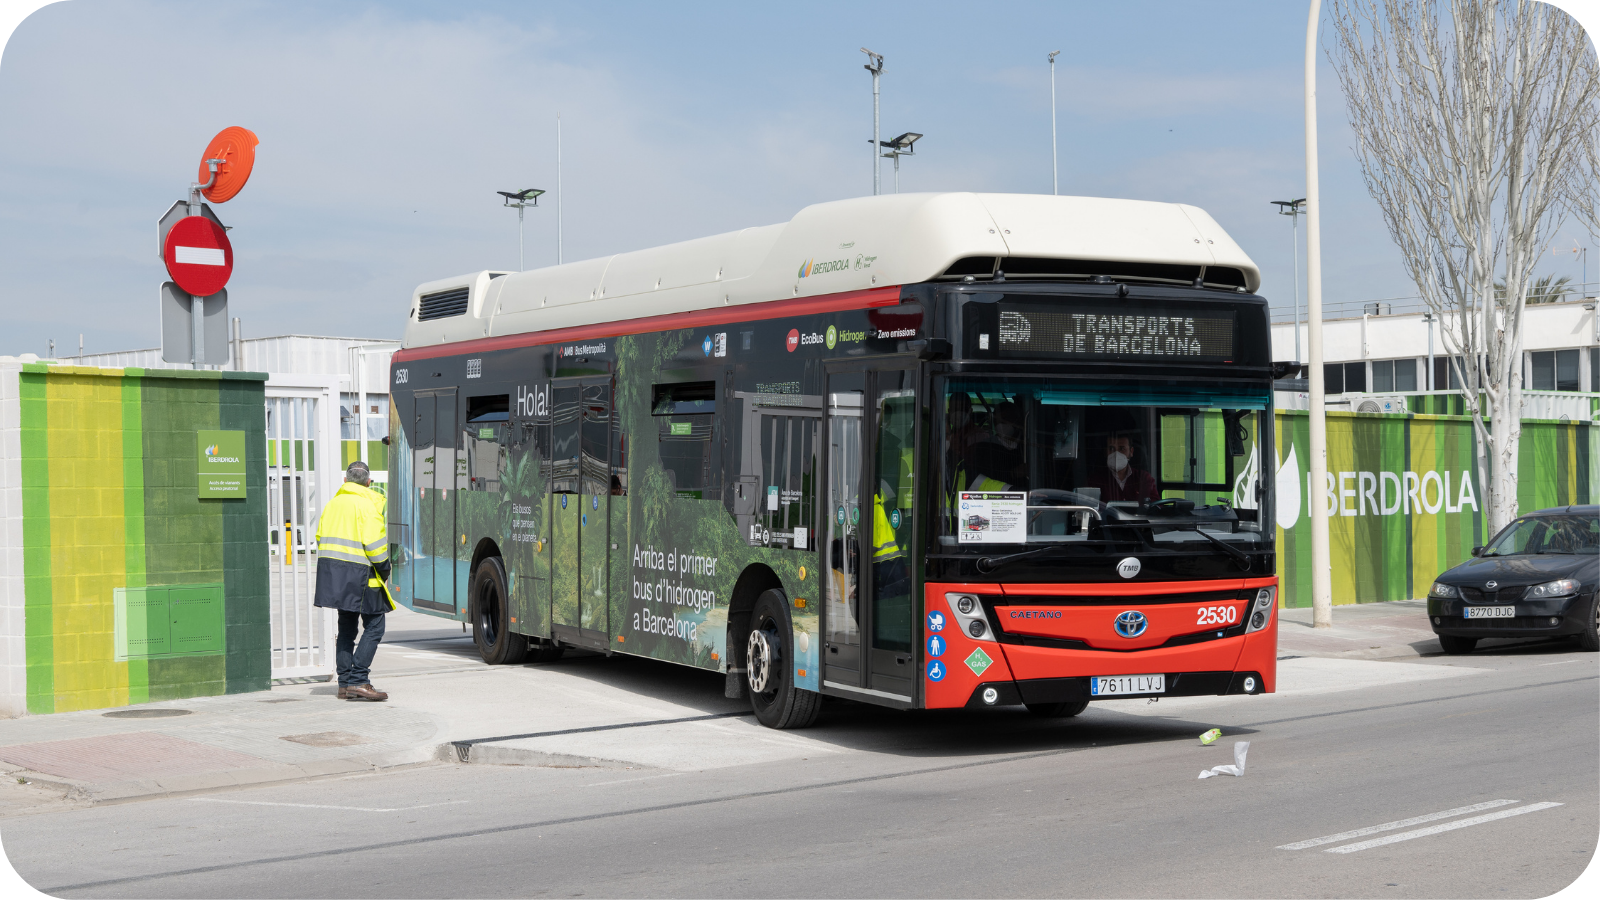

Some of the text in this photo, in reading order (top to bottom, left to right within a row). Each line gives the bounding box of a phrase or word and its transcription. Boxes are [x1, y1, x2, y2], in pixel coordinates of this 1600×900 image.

[811, 259, 849, 276] IBERDROLA
[877, 327, 916, 339] Zero emissions
[1072, 314, 1195, 336] TRANSPORTS
[704, 341, 711, 351] W
[801, 333, 824, 345] EcoBus
[1063, 333, 1201, 356] DE BARCELONA
[563, 346, 574, 357] AMB
[395, 368, 409, 385] 2530
[517, 383, 549, 417] Hola!
[1307, 470, 1479, 518] IBERDROLA
[519, 504, 532, 515] busos
[512, 520, 520, 530] que
[633, 543, 718, 579] Arriba el primer
[1123, 564, 1139, 572] TMB
[633, 575, 716, 614] bus d’hidrogen
[1010, 611, 1063, 619] CAETANO
[1196, 605, 1237, 626] 2530
[1469, 607, 1513, 617] 8770 DJC
[633, 607, 698, 641] a Barcelona
[1101, 676, 1162, 693] 7611 LVJ
